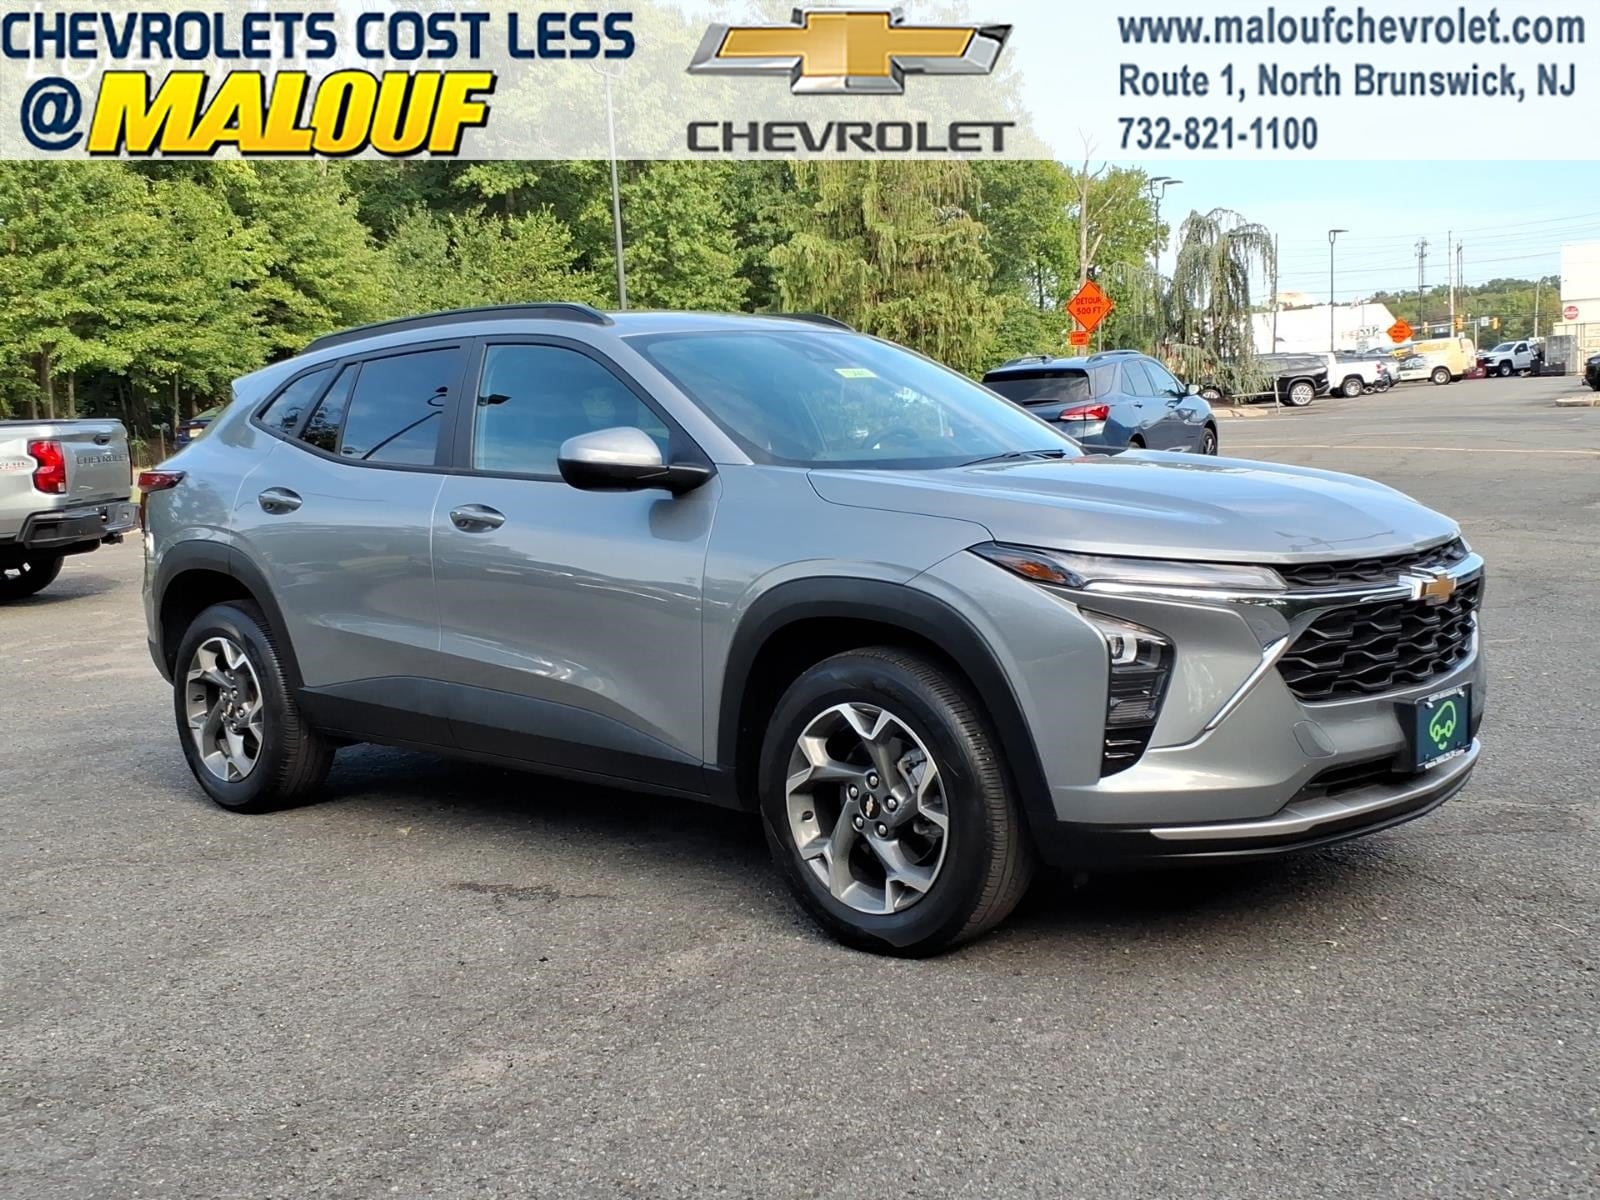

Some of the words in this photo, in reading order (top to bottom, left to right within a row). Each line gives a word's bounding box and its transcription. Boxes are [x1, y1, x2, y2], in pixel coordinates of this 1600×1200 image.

[1075, 296, 1102, 305] DETOUR
[1077, 307, 1091, 315] 500
[1092, 306, 1101, 314] FT
